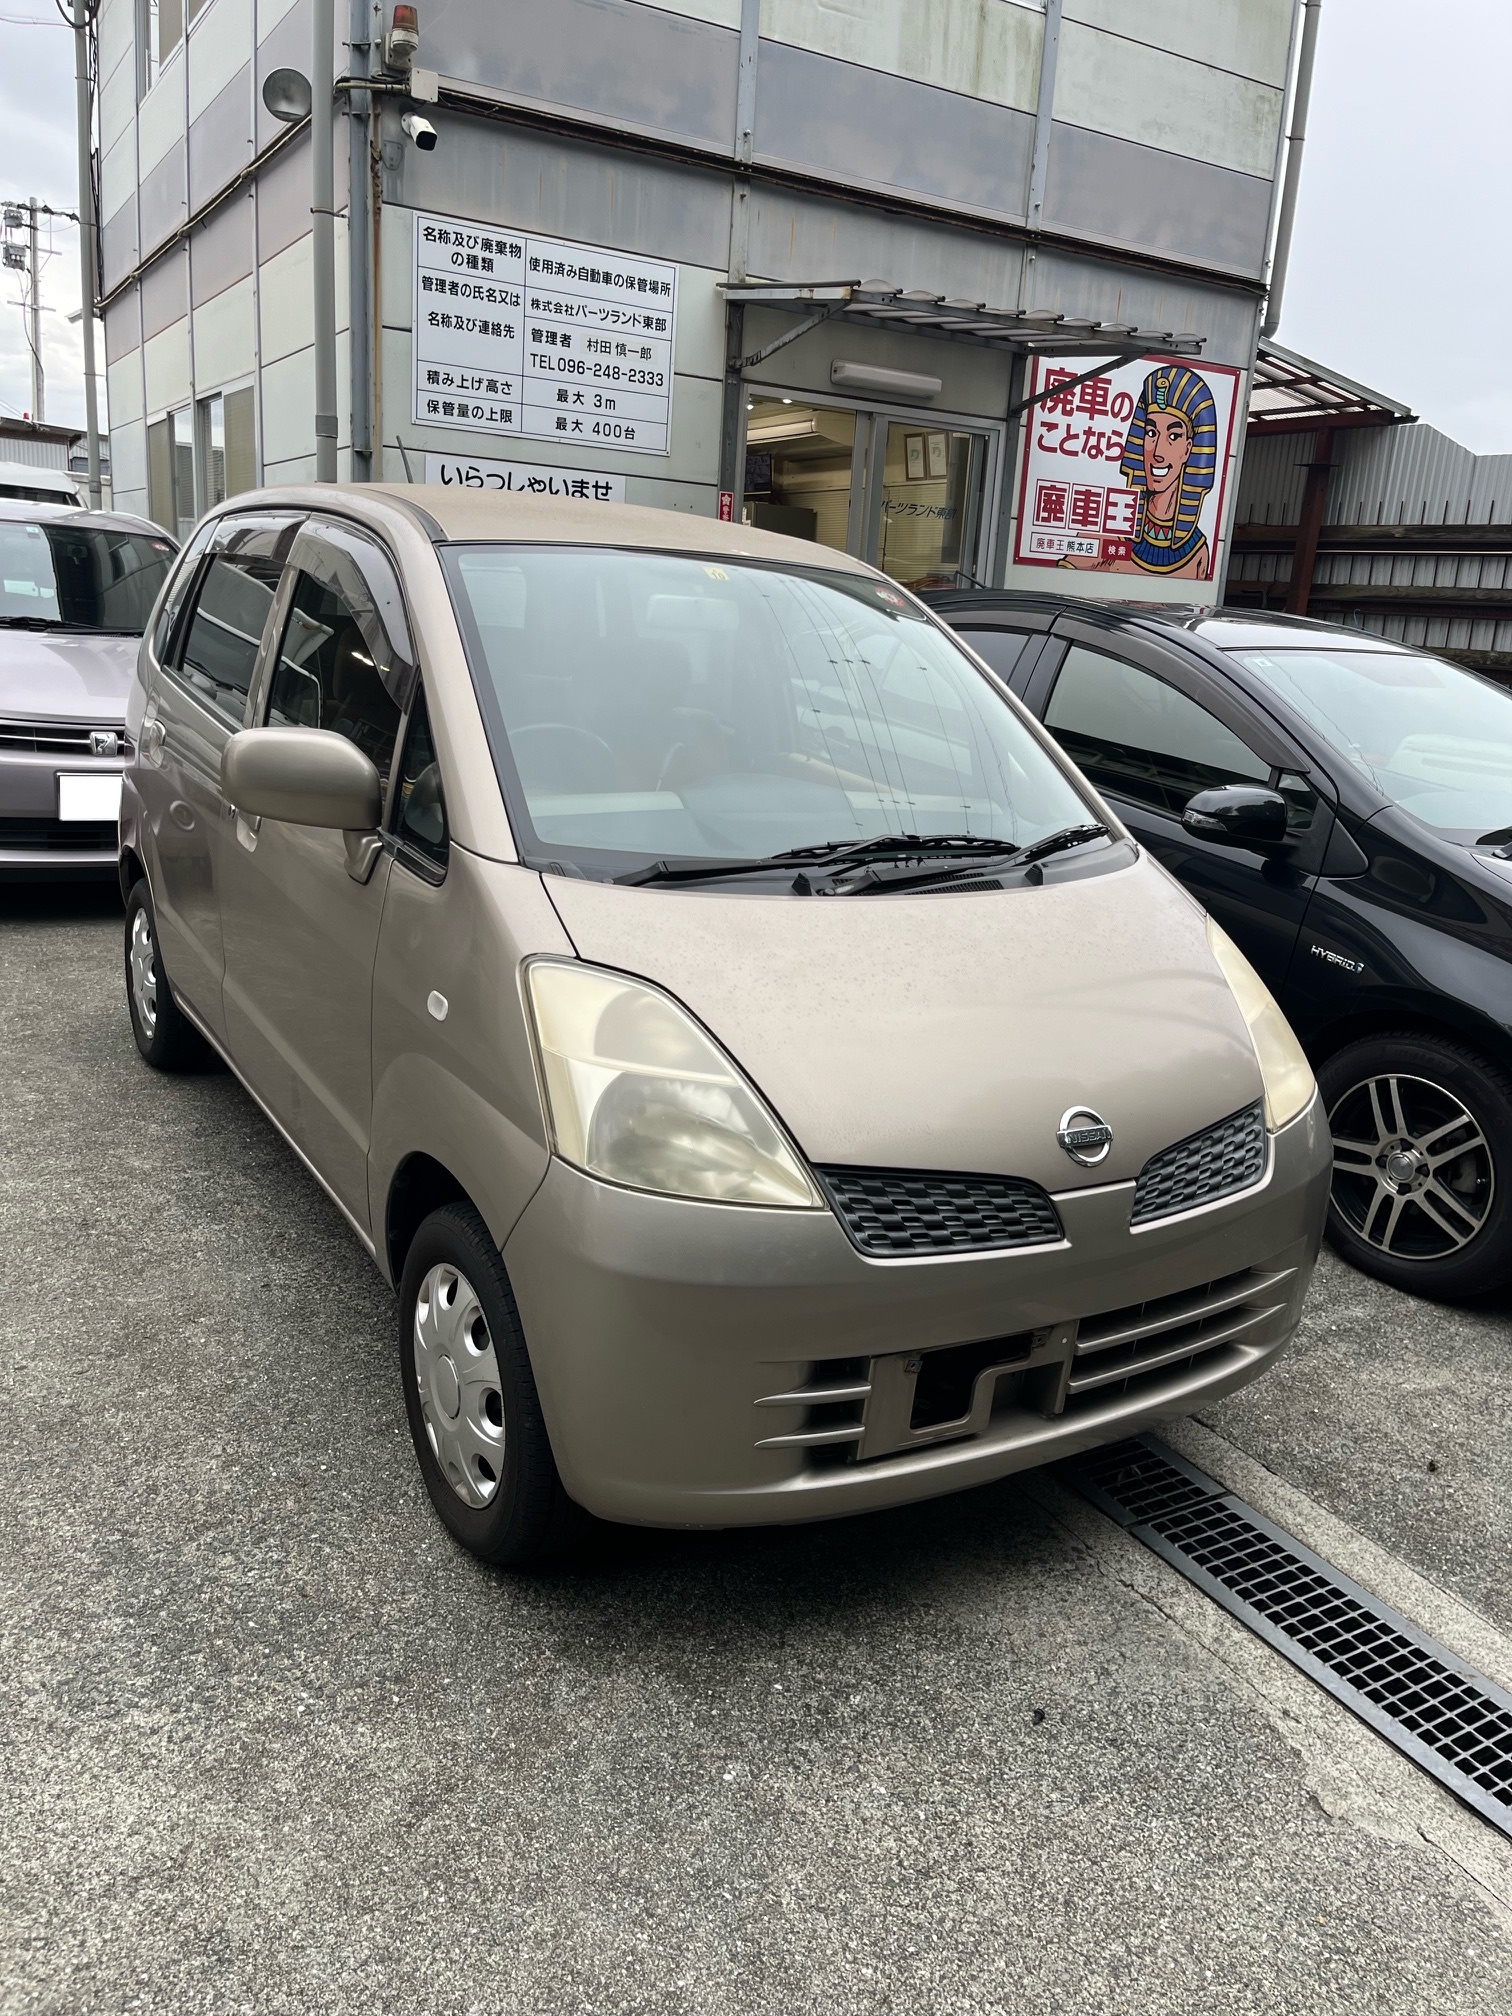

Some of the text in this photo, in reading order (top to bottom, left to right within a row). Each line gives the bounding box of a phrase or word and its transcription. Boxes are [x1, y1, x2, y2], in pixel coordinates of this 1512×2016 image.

[423, 226, 522, 258] 名称及び廃棄物
[451, 251, 494, 272] の種類
[529, 257, 671, 297] 使用済み自動車の保管場所
[422, 276, 521, 307] 管理者の氏名又は
[428, 311, 515, 338] 名称及び連絡先
[530, 298, 667, 332] 株式会社パーツランド東部
[531, 328, 572, 348] 管理者
[427, 370, 513, 395] 積み上げ高さ
[530, 353, 664, 386] TEL096-248-2333
[557, 389, 616, 410] 最大 3m
[1040, 367, 1134, 422] 廃車の
[427, 399, 513, 423] 保管量の上限
[556, 417, 635, 440] 最大 400台
[1037, 421, 1125, 462] ことなら
[441, 464, 612, 501] いらっしゃいませ
[1034, 481, 1140, 537] 廃車王
